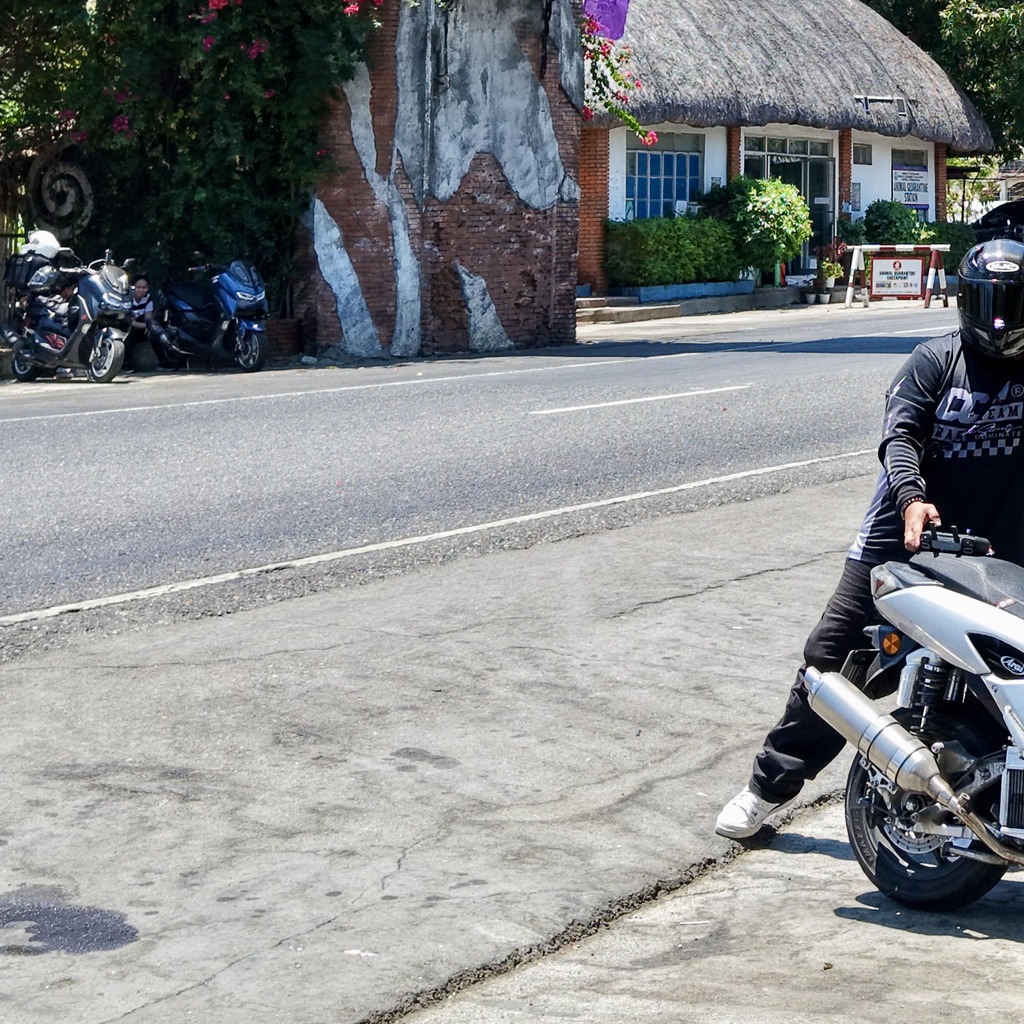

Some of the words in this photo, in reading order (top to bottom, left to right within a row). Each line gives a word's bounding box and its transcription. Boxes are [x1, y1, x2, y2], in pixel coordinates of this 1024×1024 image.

[894, 181, 907, 192] ANIMAL
[904, 192, 918, 203] STATION
[1003, 657, 1024, 674] Arai
